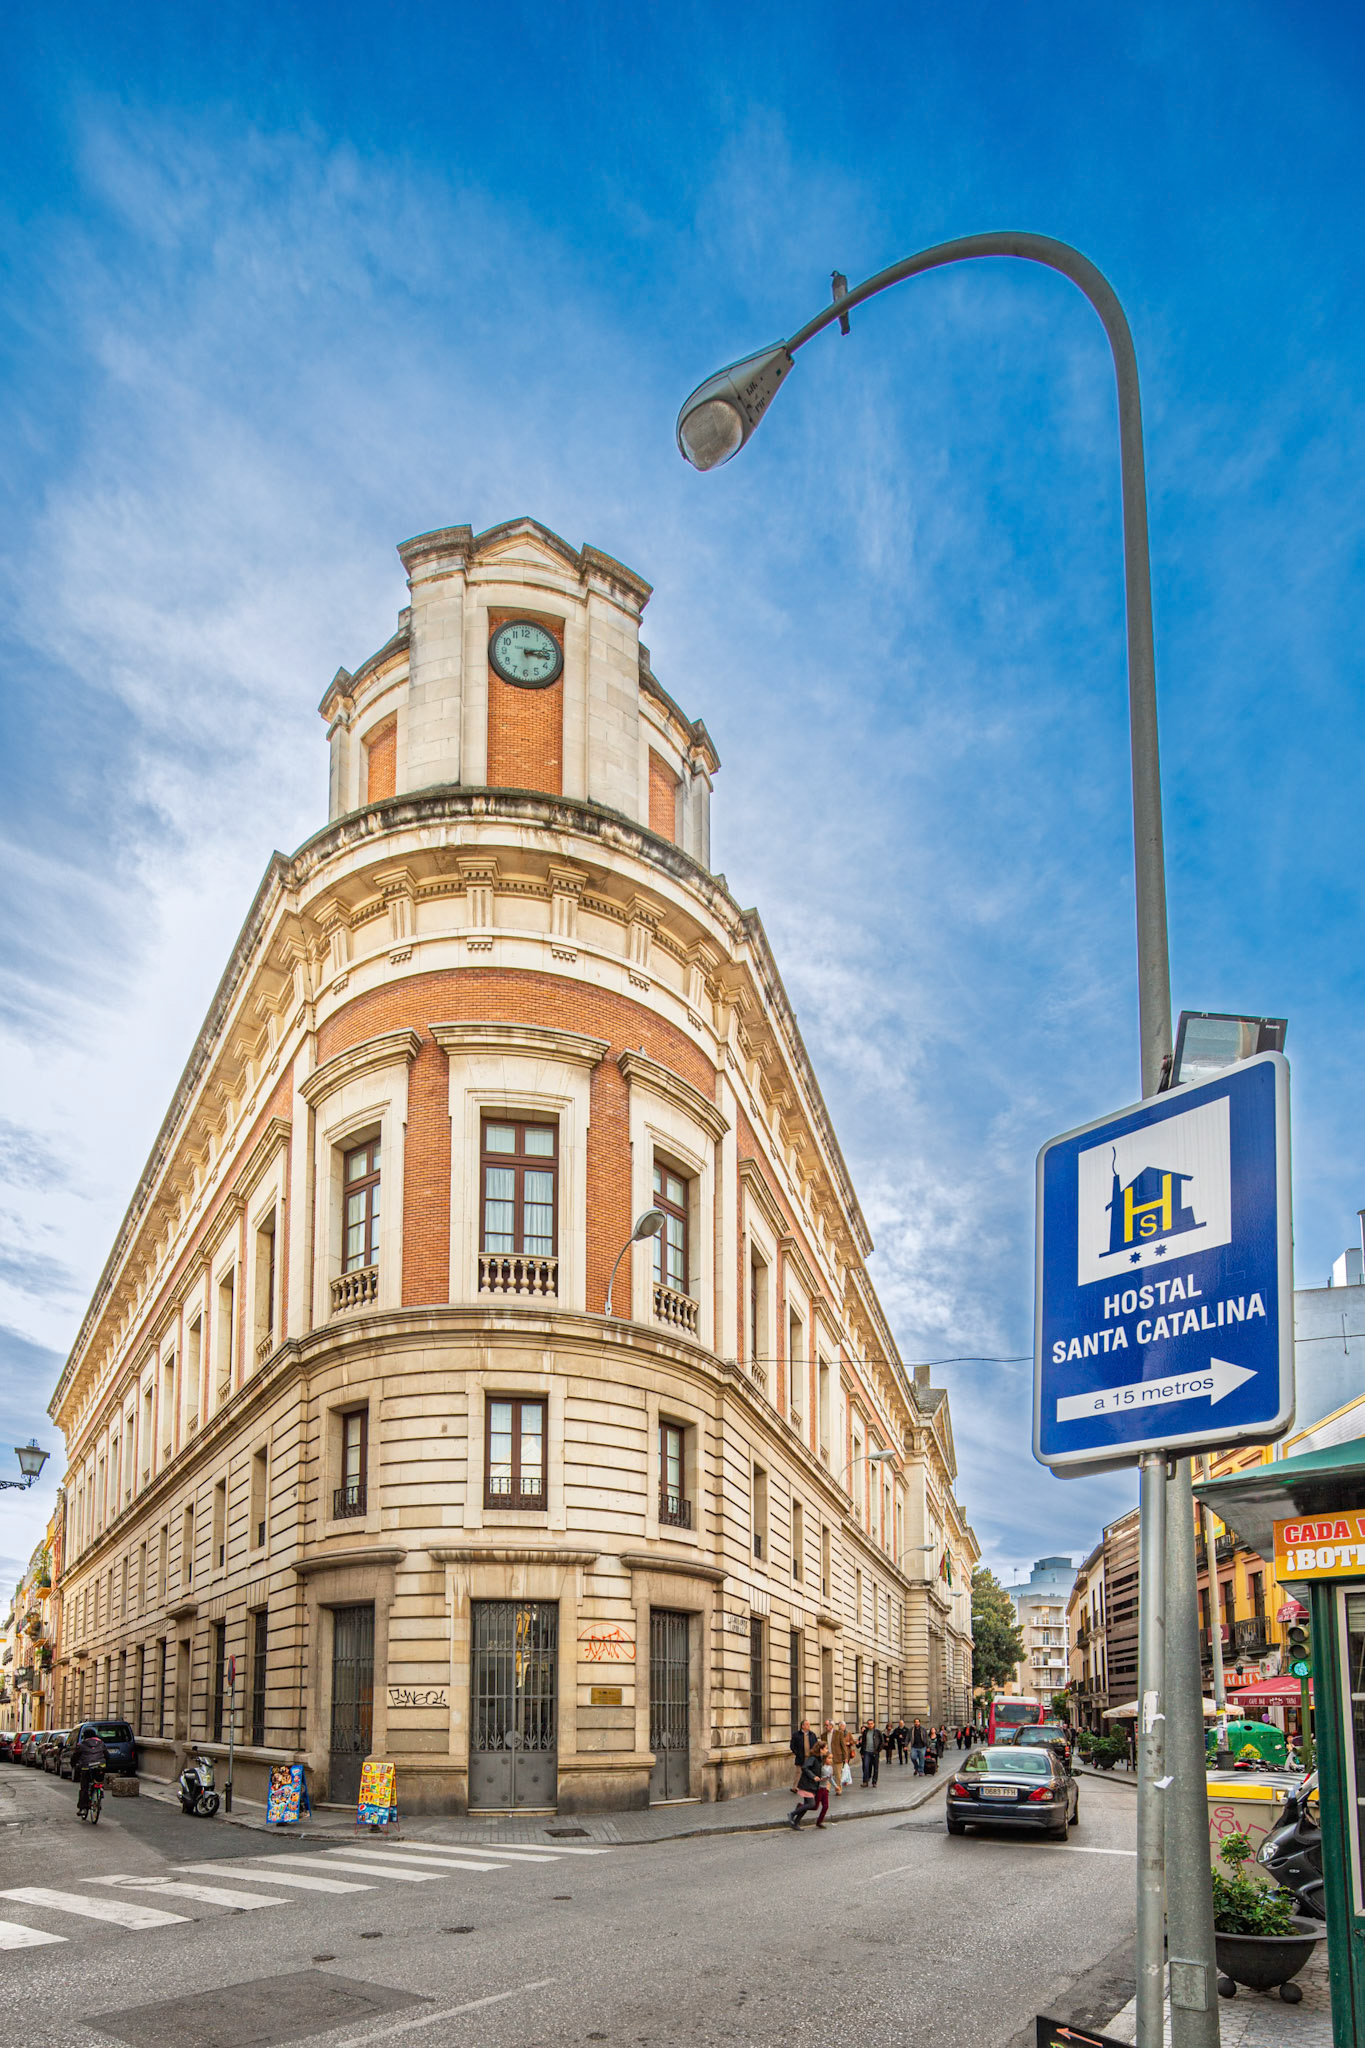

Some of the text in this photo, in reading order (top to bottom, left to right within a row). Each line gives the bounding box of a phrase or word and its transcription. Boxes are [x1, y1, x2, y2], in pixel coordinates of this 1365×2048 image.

[512, 631, 518, 639] 11
[522, 629, 530, 638] 12
[503, 637, 511, 646] 10
[501, 646, 507, 655] 9
[505, 656, 510, 665] 8
[513, 665, 518, 673] 7
[522, 669, 529, 677] 6
[1104, 1273, 1202, 1320] HOSTAL
[1052, 1292, 1266, 1364] SANTA CATALINA
[1093, 1377, 1214, 1410] a 15 metros
[1284, 1519, 1352, 1544] CADA
